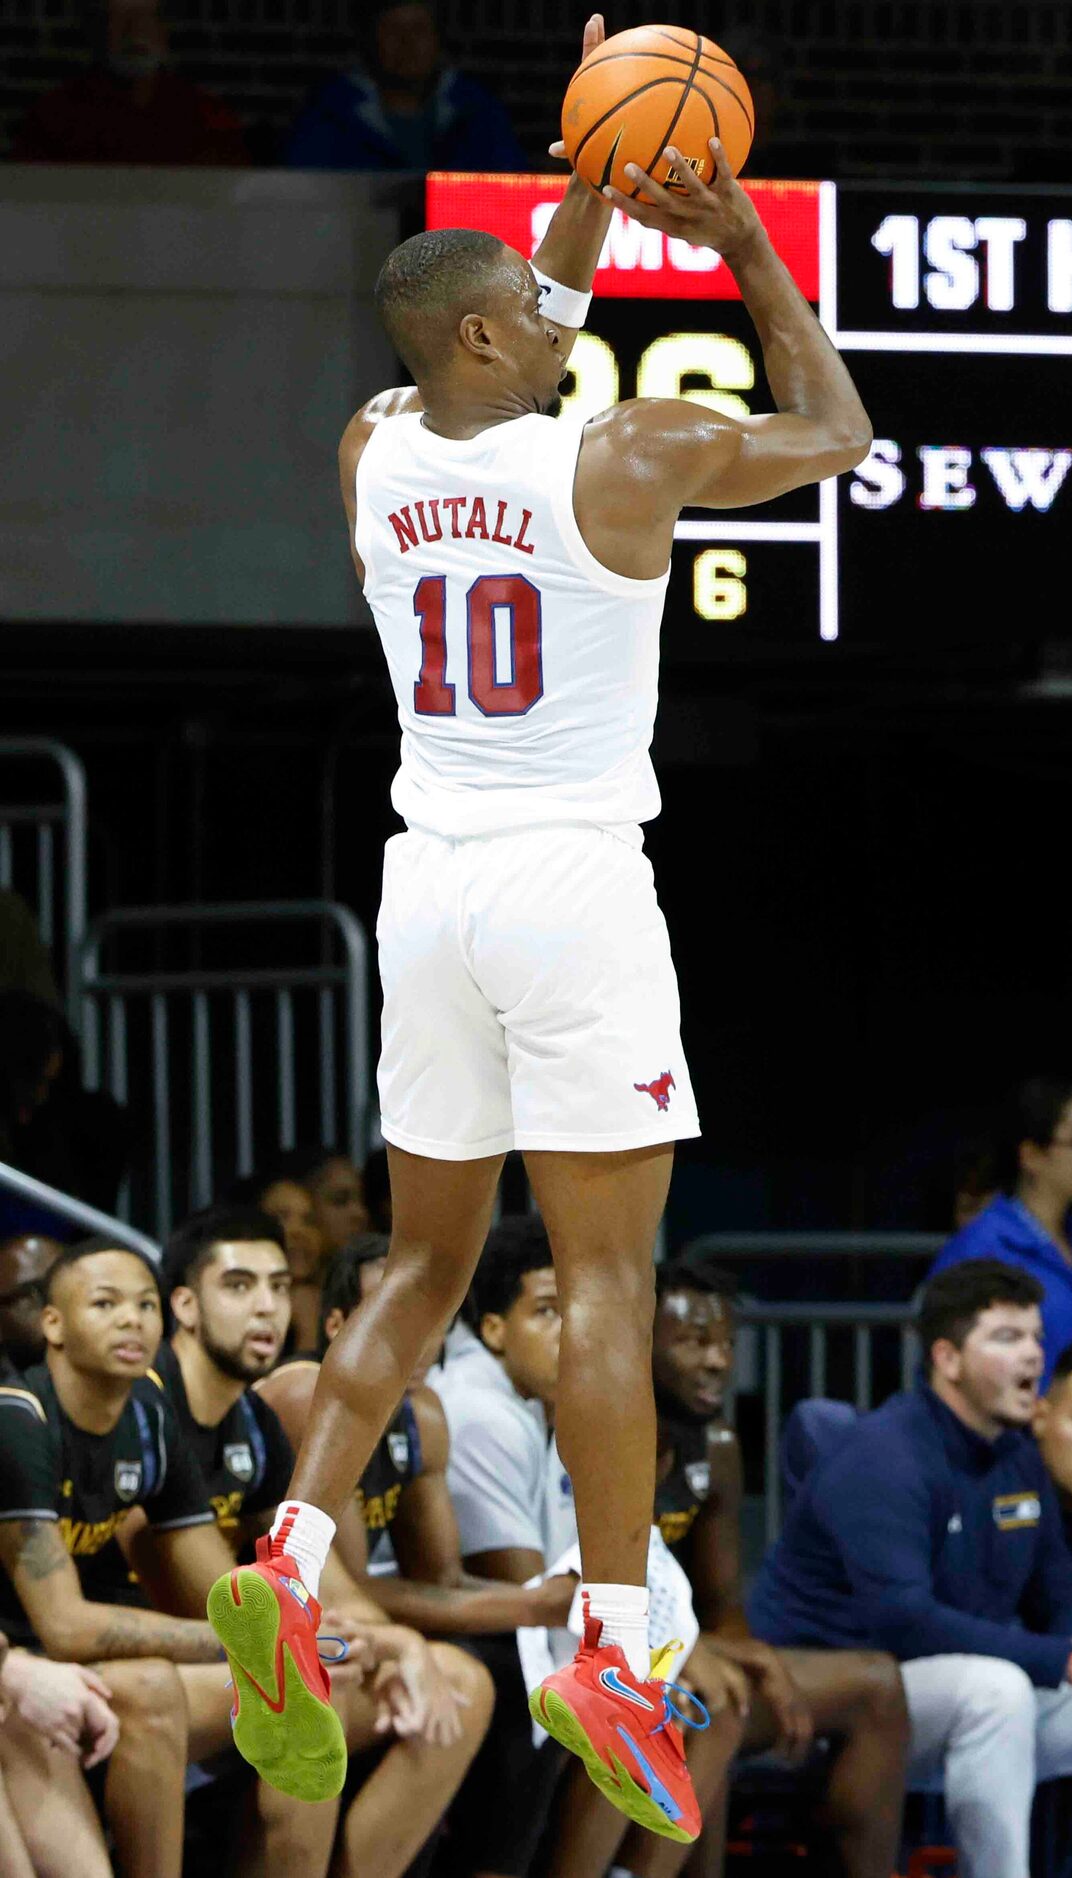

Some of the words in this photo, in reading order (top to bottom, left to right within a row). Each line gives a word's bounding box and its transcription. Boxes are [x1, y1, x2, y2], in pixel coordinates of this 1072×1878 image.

[869, 213, 1027, 312] 1ST
[387, 496, 535, 555] NUTALL
[692, 548, 748, 621] 6
[412, 572, 545, 718] 10
